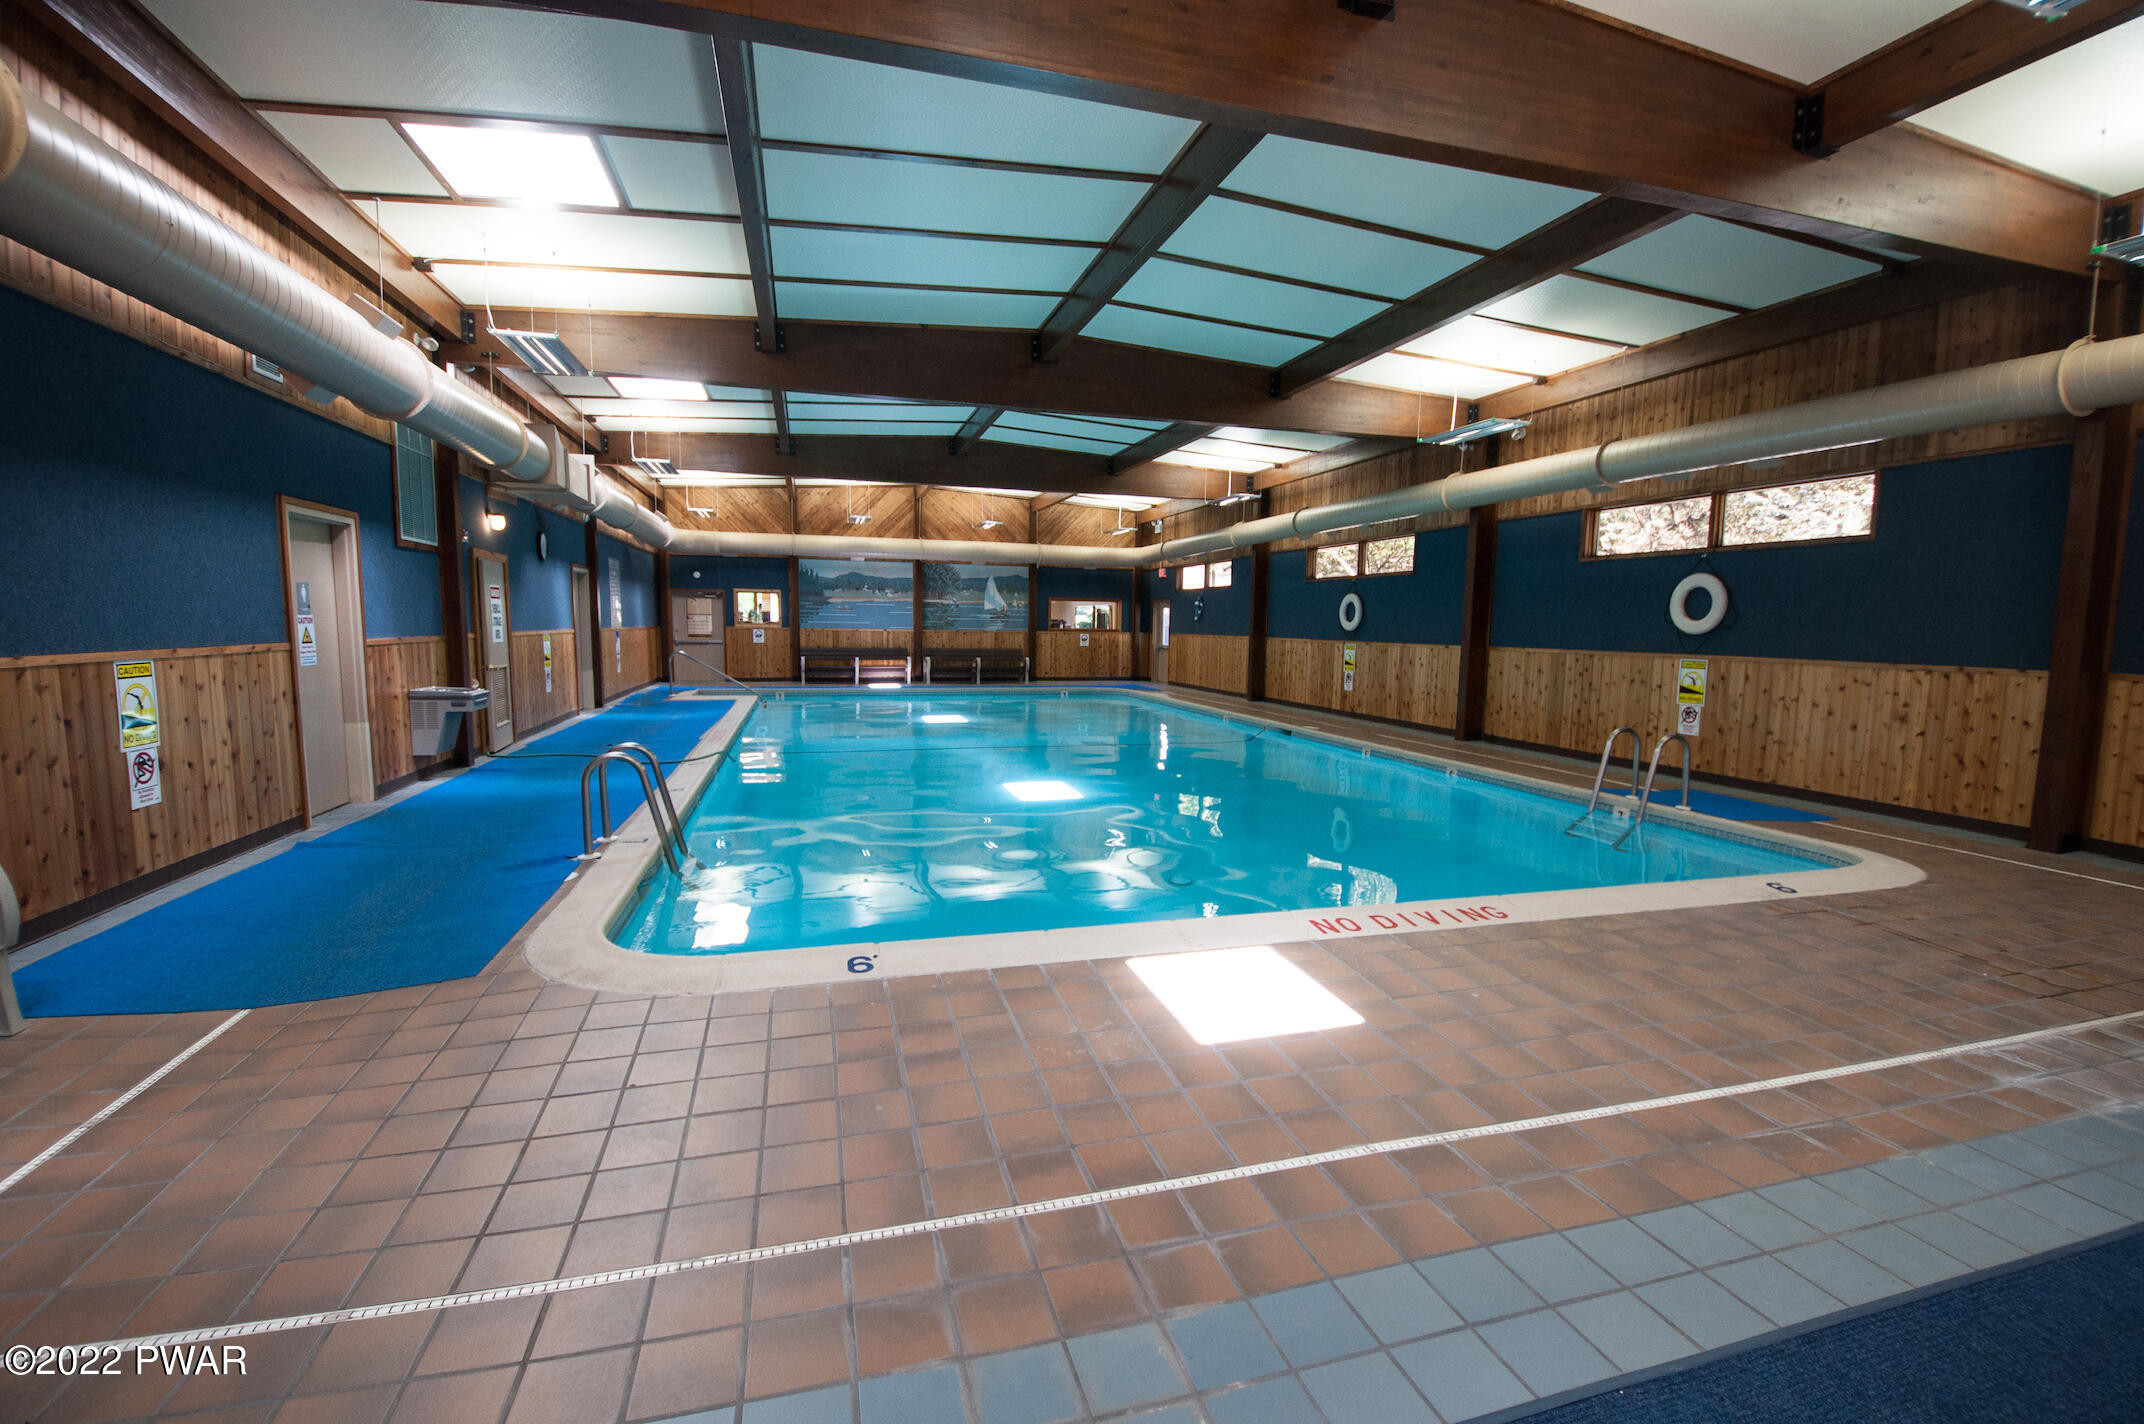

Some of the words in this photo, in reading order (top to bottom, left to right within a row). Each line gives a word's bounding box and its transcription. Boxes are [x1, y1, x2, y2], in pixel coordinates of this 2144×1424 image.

[118, 665, 150, 676] CAUTION
[124, 734, 134, 744] NO
[1307, 917, 1362, 934] NO
[1368, 906, 1509, 929] DIVING
